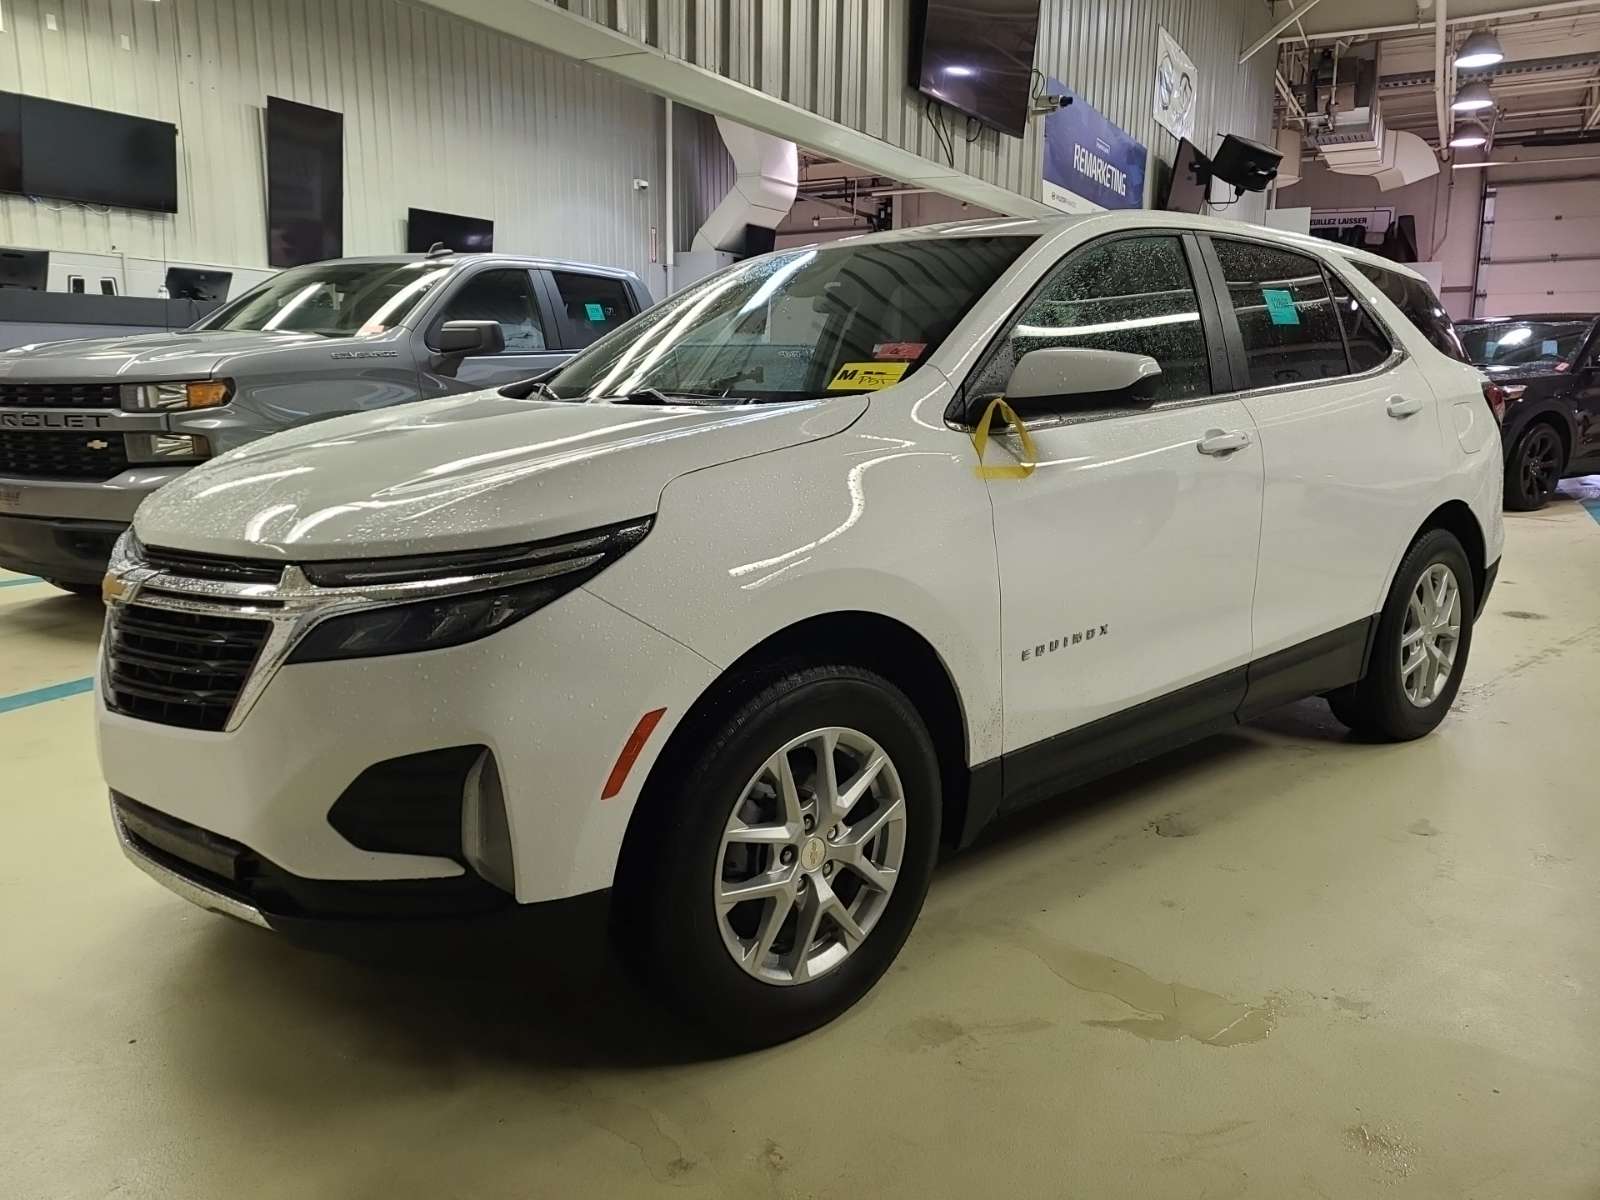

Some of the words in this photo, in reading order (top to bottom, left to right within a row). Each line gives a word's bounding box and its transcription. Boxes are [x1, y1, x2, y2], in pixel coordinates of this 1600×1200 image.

[1073, 143, 1127, 197] REMARKETING
[1338, 216, 1368, 225] LAISSER
[837, 369, 858, 381] M
[1021, 623, 1109, 662] EQUINOX
